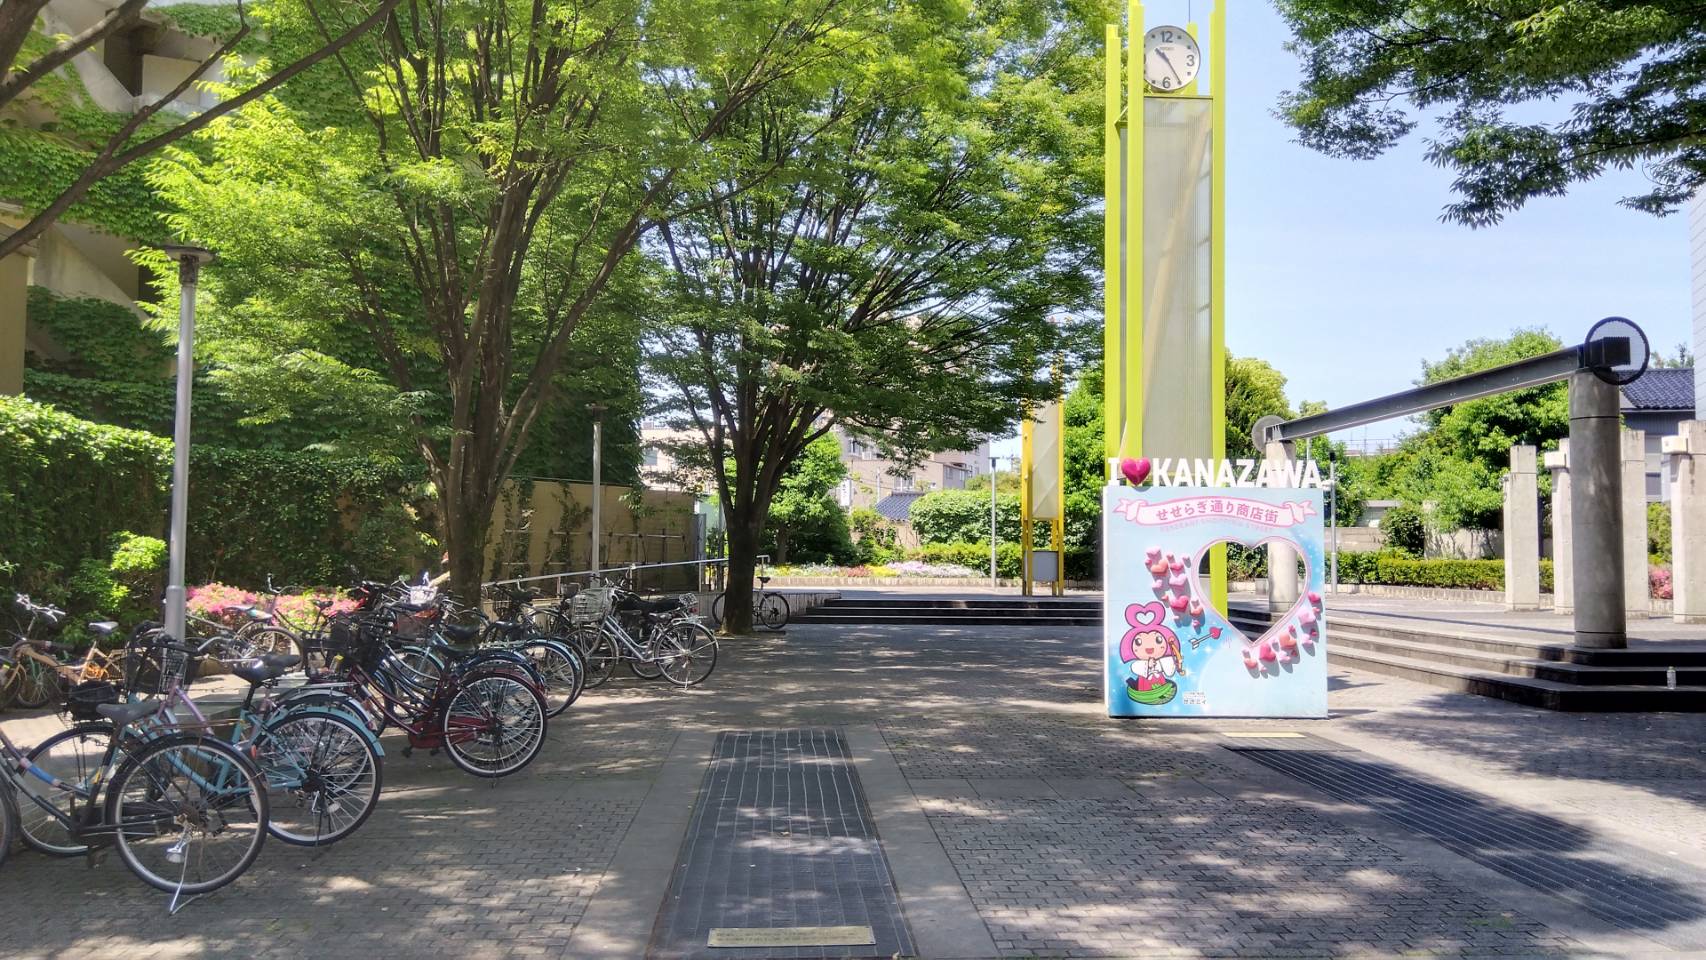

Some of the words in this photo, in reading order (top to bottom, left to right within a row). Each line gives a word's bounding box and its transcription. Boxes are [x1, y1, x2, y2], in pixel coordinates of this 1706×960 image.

[1160, 31, 1173, 43] 12
[1186, 55, 1195, 67] 3
[1162, 77, 1171, 89] 6
[1108, 458, 1121, 487] I
[1153, 457, 1323, 488] KANAZAWA
[1156, 500, 1279, 523] せせらぎ通り商店街
